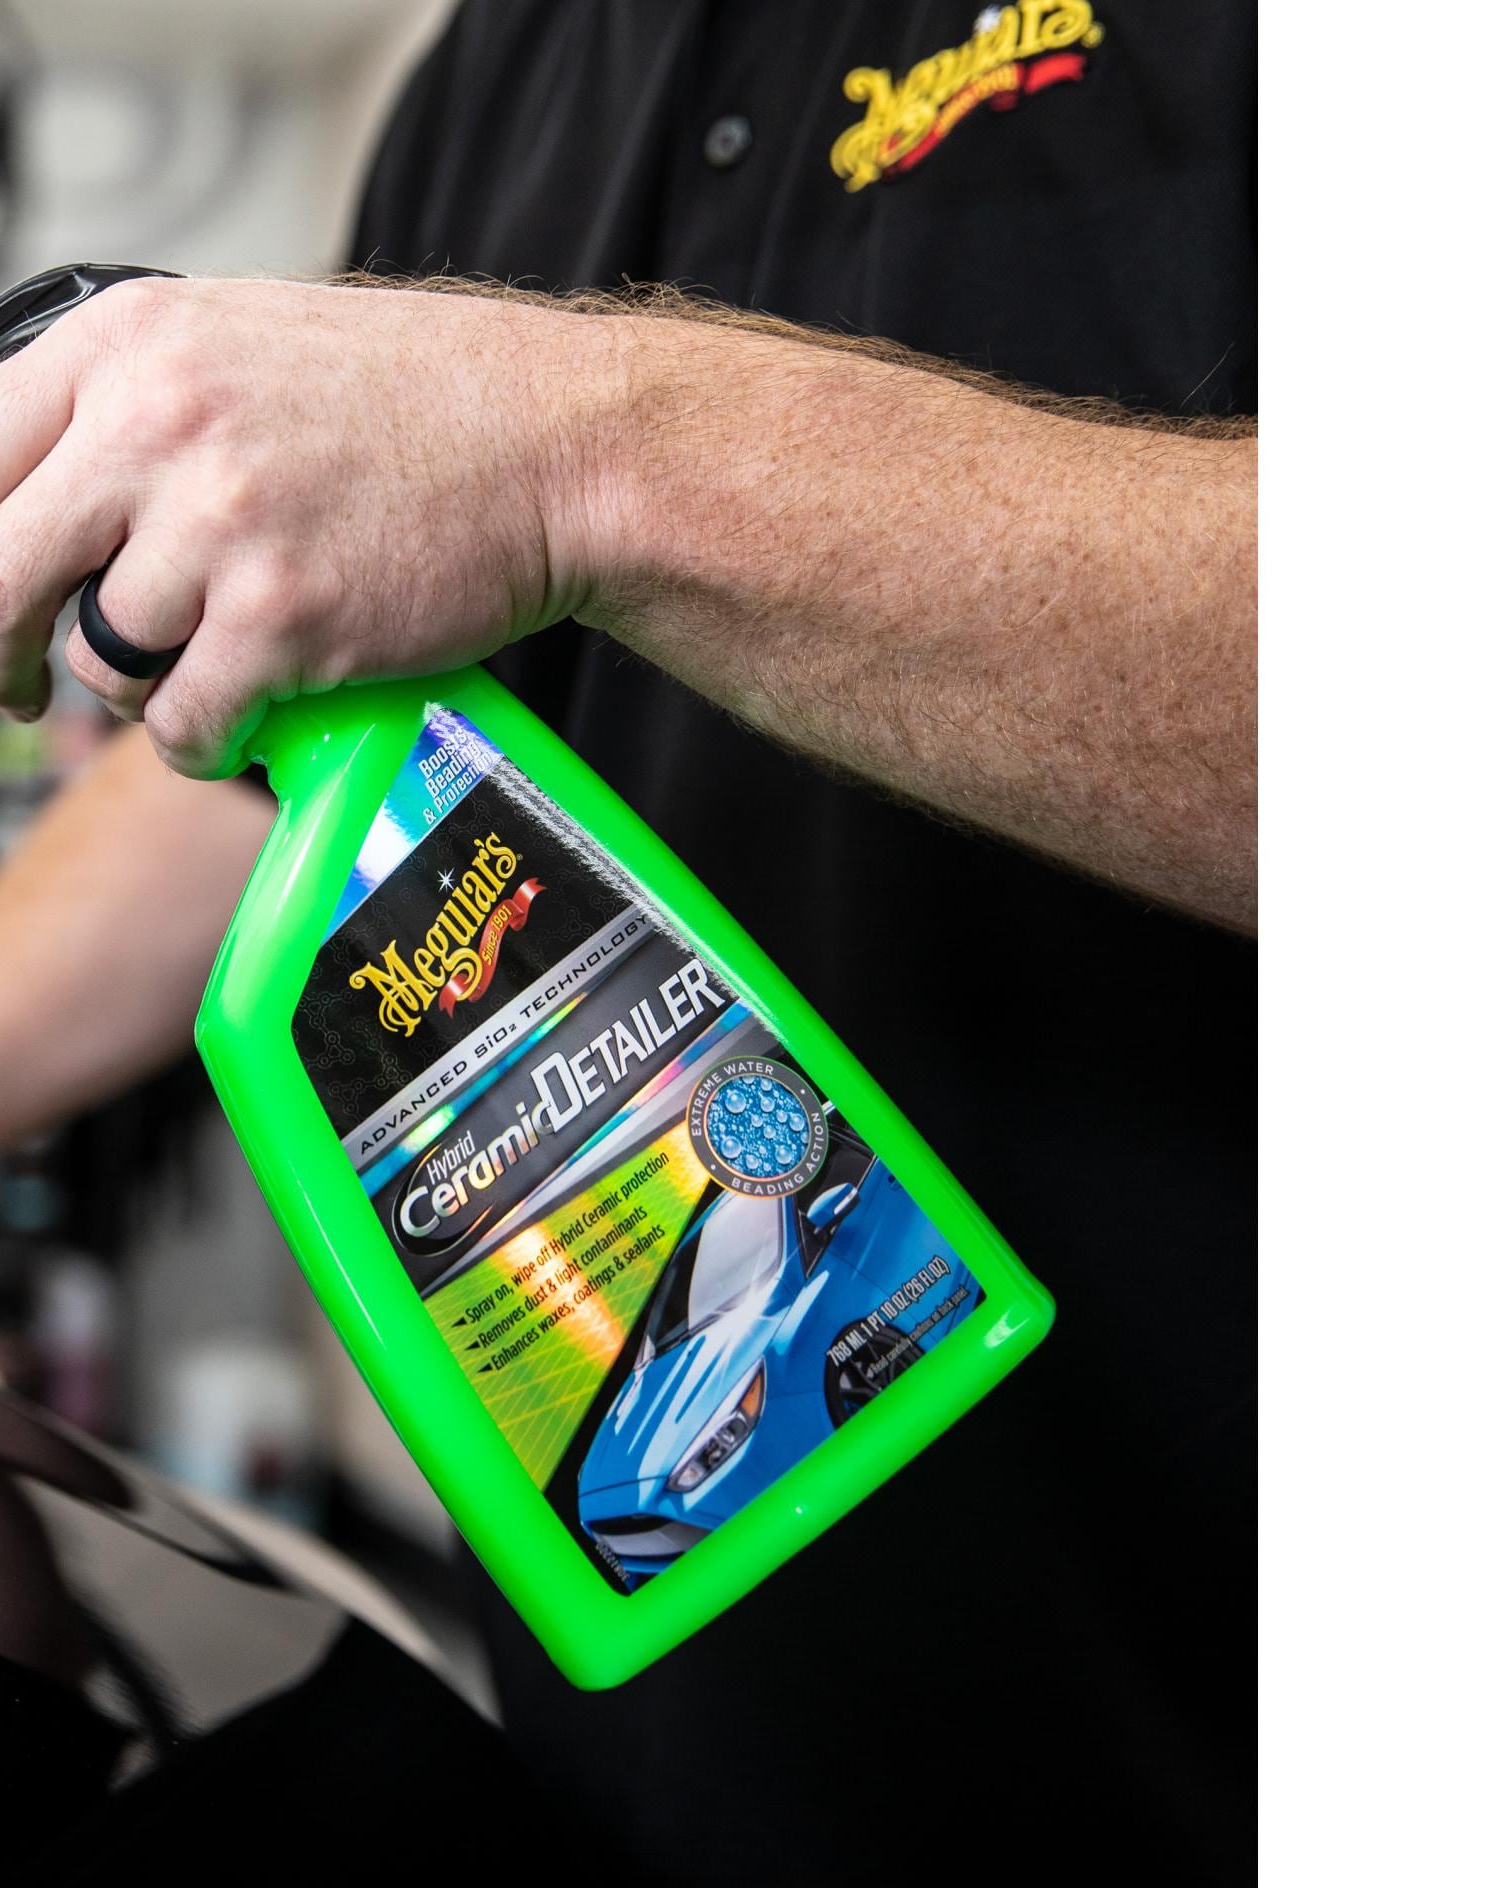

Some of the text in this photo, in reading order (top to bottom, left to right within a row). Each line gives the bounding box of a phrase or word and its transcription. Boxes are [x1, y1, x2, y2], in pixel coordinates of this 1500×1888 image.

[418, 729, 468, 780] Boosts
[423, 751, 492, 825] & Protection
[425, 741, 483, 799] Beading
[349, 832, 517, 1037] Meguiar's
[481, 905, 512, 966] Since 1901
[360, 1060, 468, 1155] ADVANCED
[520, 915, 650, 1019] TECHNOLOGY
[400, 958, 726, 1238] Ceramic DETAILER
[691, 1061, 774, 1136] EXTREME WATER
[426, 1130, 475, 1186] Hybrid
[732, 1112, 824, 1195] BEADING ACTION
[465, 1150, 670, 1324] Spray on, wipe off Hybrid Ceramic protection
[478, 1204, 648, 1349] Removes dust & light contaminants
[491, 1223, 666, 1371] Enhances waxes, coatings & sealants
[827, 1256, 950, 1367] 768 ML 1 PT 10 OZ (26 FL OZ)
